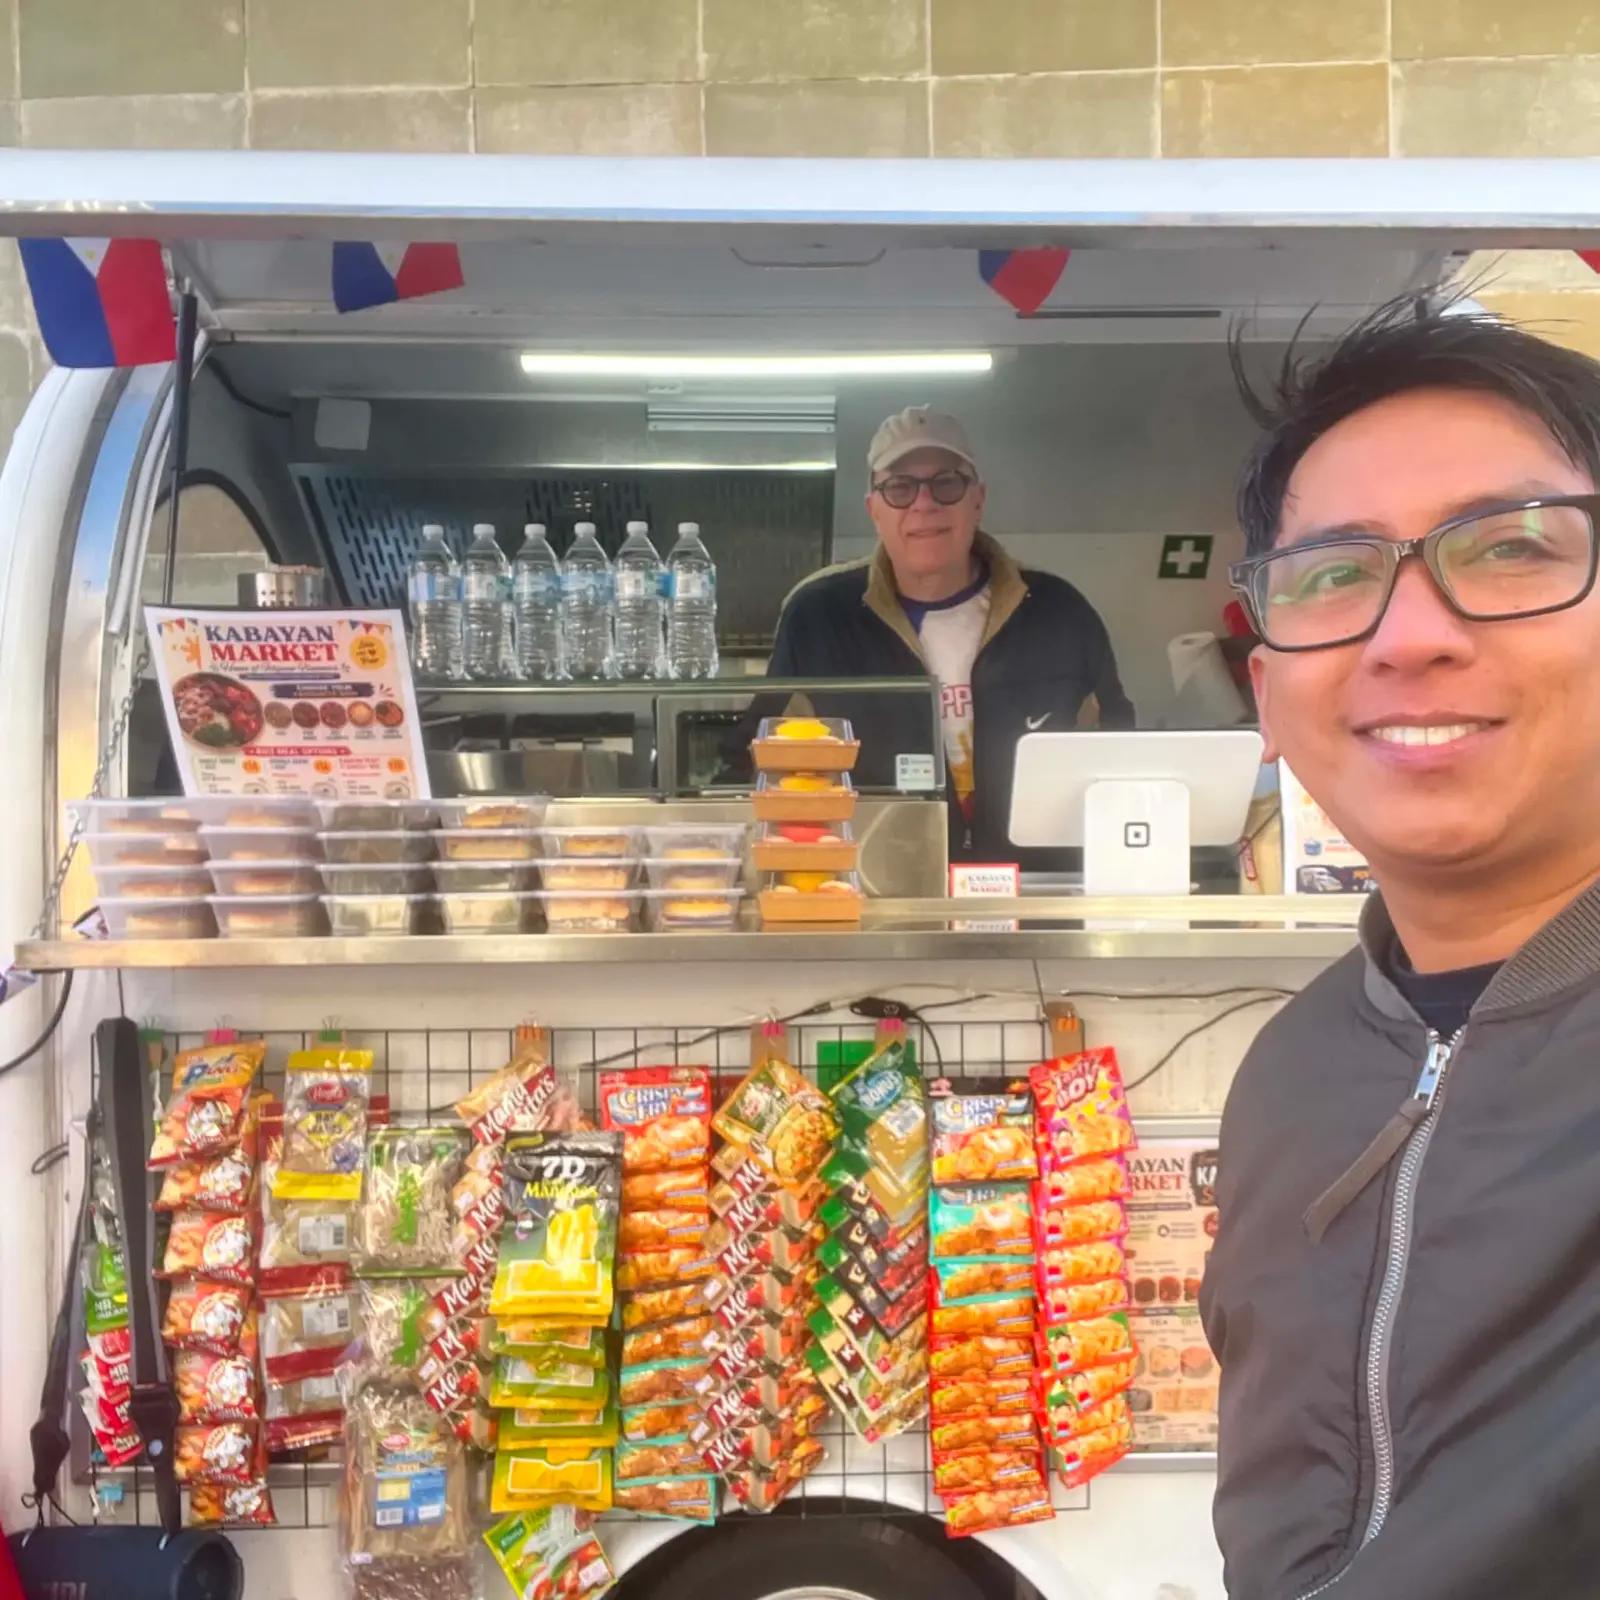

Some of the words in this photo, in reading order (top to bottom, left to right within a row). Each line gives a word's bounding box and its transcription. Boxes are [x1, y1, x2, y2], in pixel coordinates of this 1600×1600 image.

[205, 625, 334, 642] KABAYAN
[211, 643, 339, 663] MARKET
[541, 1155, 586, 1178] 7D
[1127, 1158, 1184, 1173] AYAN
[1131, 1175, 1183, 1190] RKET
